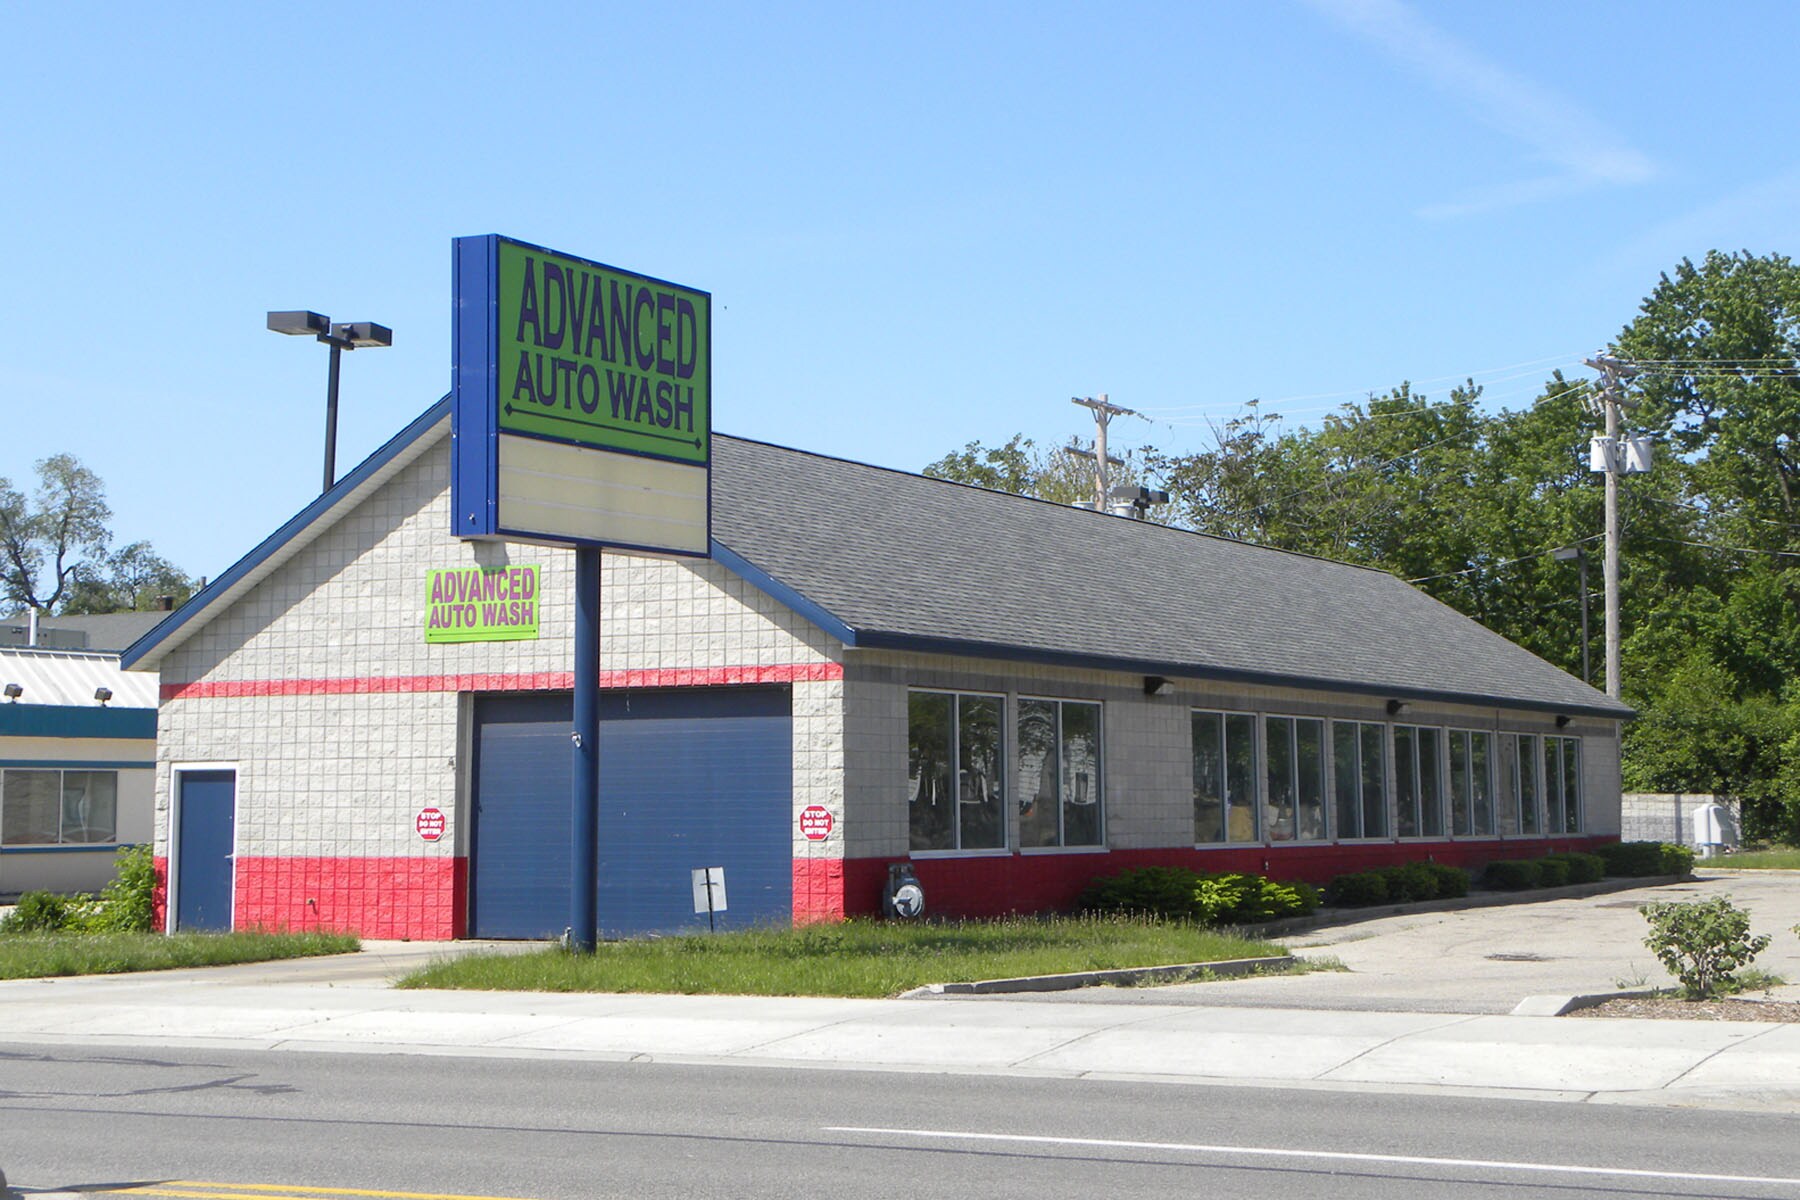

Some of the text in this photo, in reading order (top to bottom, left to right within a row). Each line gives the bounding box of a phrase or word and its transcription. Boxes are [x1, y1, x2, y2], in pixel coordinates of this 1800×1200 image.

[516, 256, 697, 380] ADVANCED
[512, 350, 695, 433] AUTO WASH
[431, 568, 535, 604] ADVANCED
[428, 602, 534, 628] AUTO WASH
[421, 812, 441, 820] STOP
[802, 819, 829, 827] DO NOT
[804, 810, 827, 818] STOP
